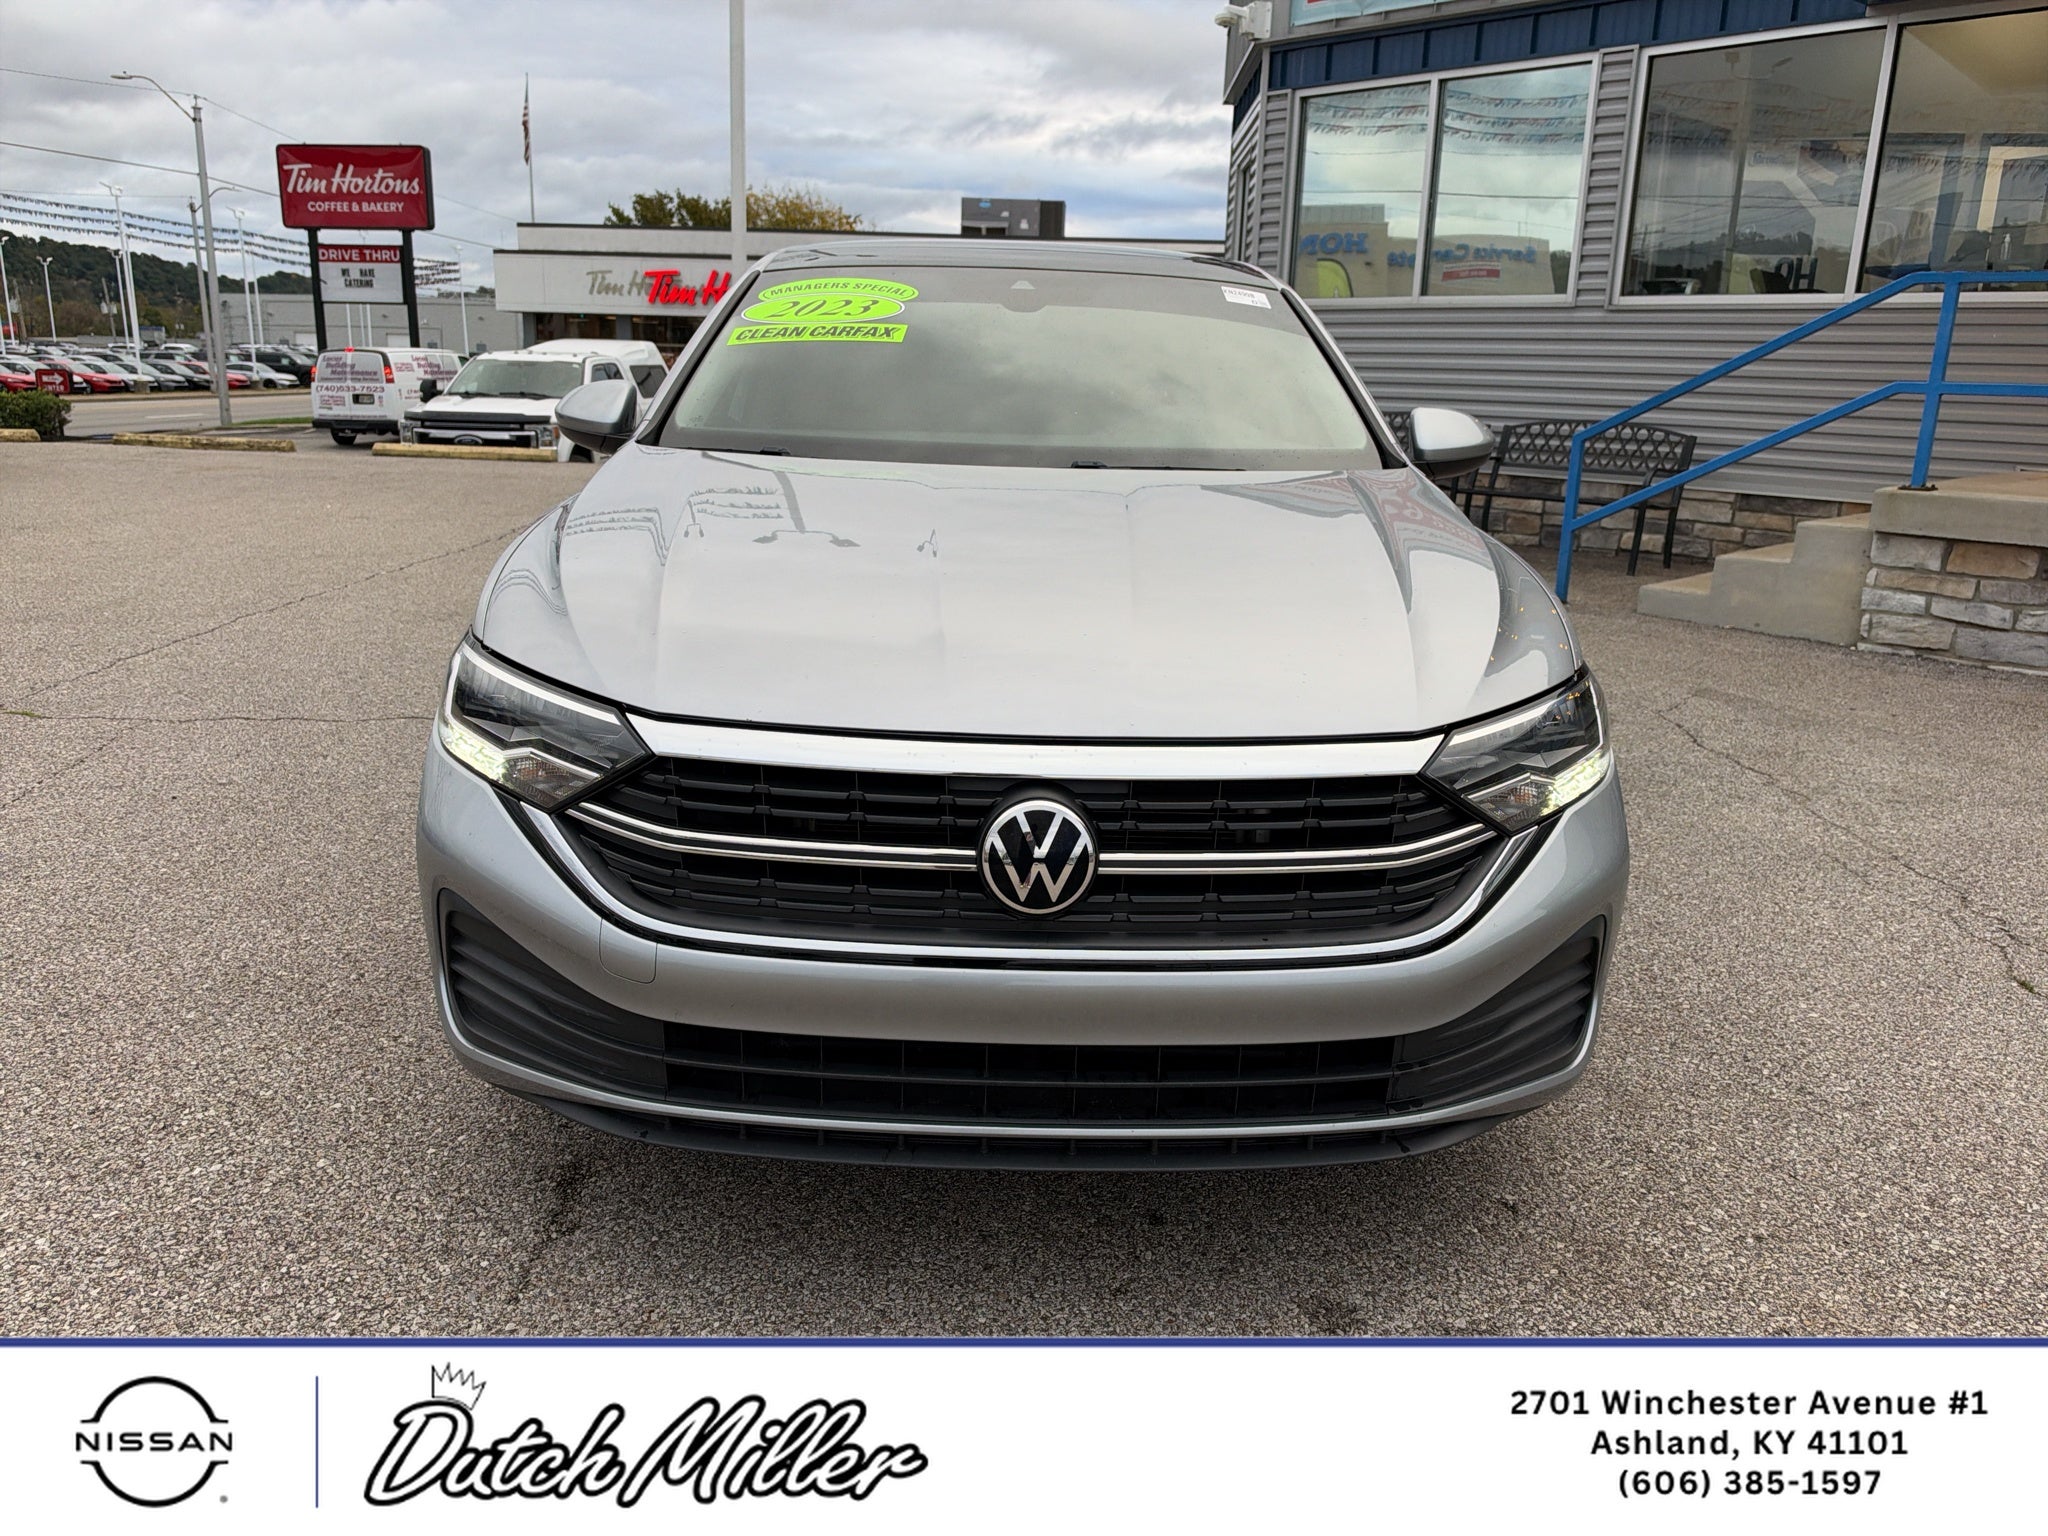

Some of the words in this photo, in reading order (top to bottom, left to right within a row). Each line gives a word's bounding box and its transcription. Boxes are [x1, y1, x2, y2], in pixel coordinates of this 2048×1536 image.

[283, 163, 327, 194] Tim
[331, 162, 421, 194] Hortons
[307, 201, 350, 212] COFFEE
[352, 202, 360, 212] &
[362, 202, 404, 213] BAKERY
[318, 248, 361, 260] DRIVE
[363, 249, 400, 262] THRU
[344, 278, 374, 288] CATERING
[586, 270, 624, 297] Tim
[643, 269, 698, 306] Tim
[770, 282, 850, 296] MANAGERS
[853, 282, 909, 297] SPECIAL
[764, 299, 880, 318] 2023
[736, 325, 808, 340] CLEAN
[808, 325, 899, 339] CARFAX
